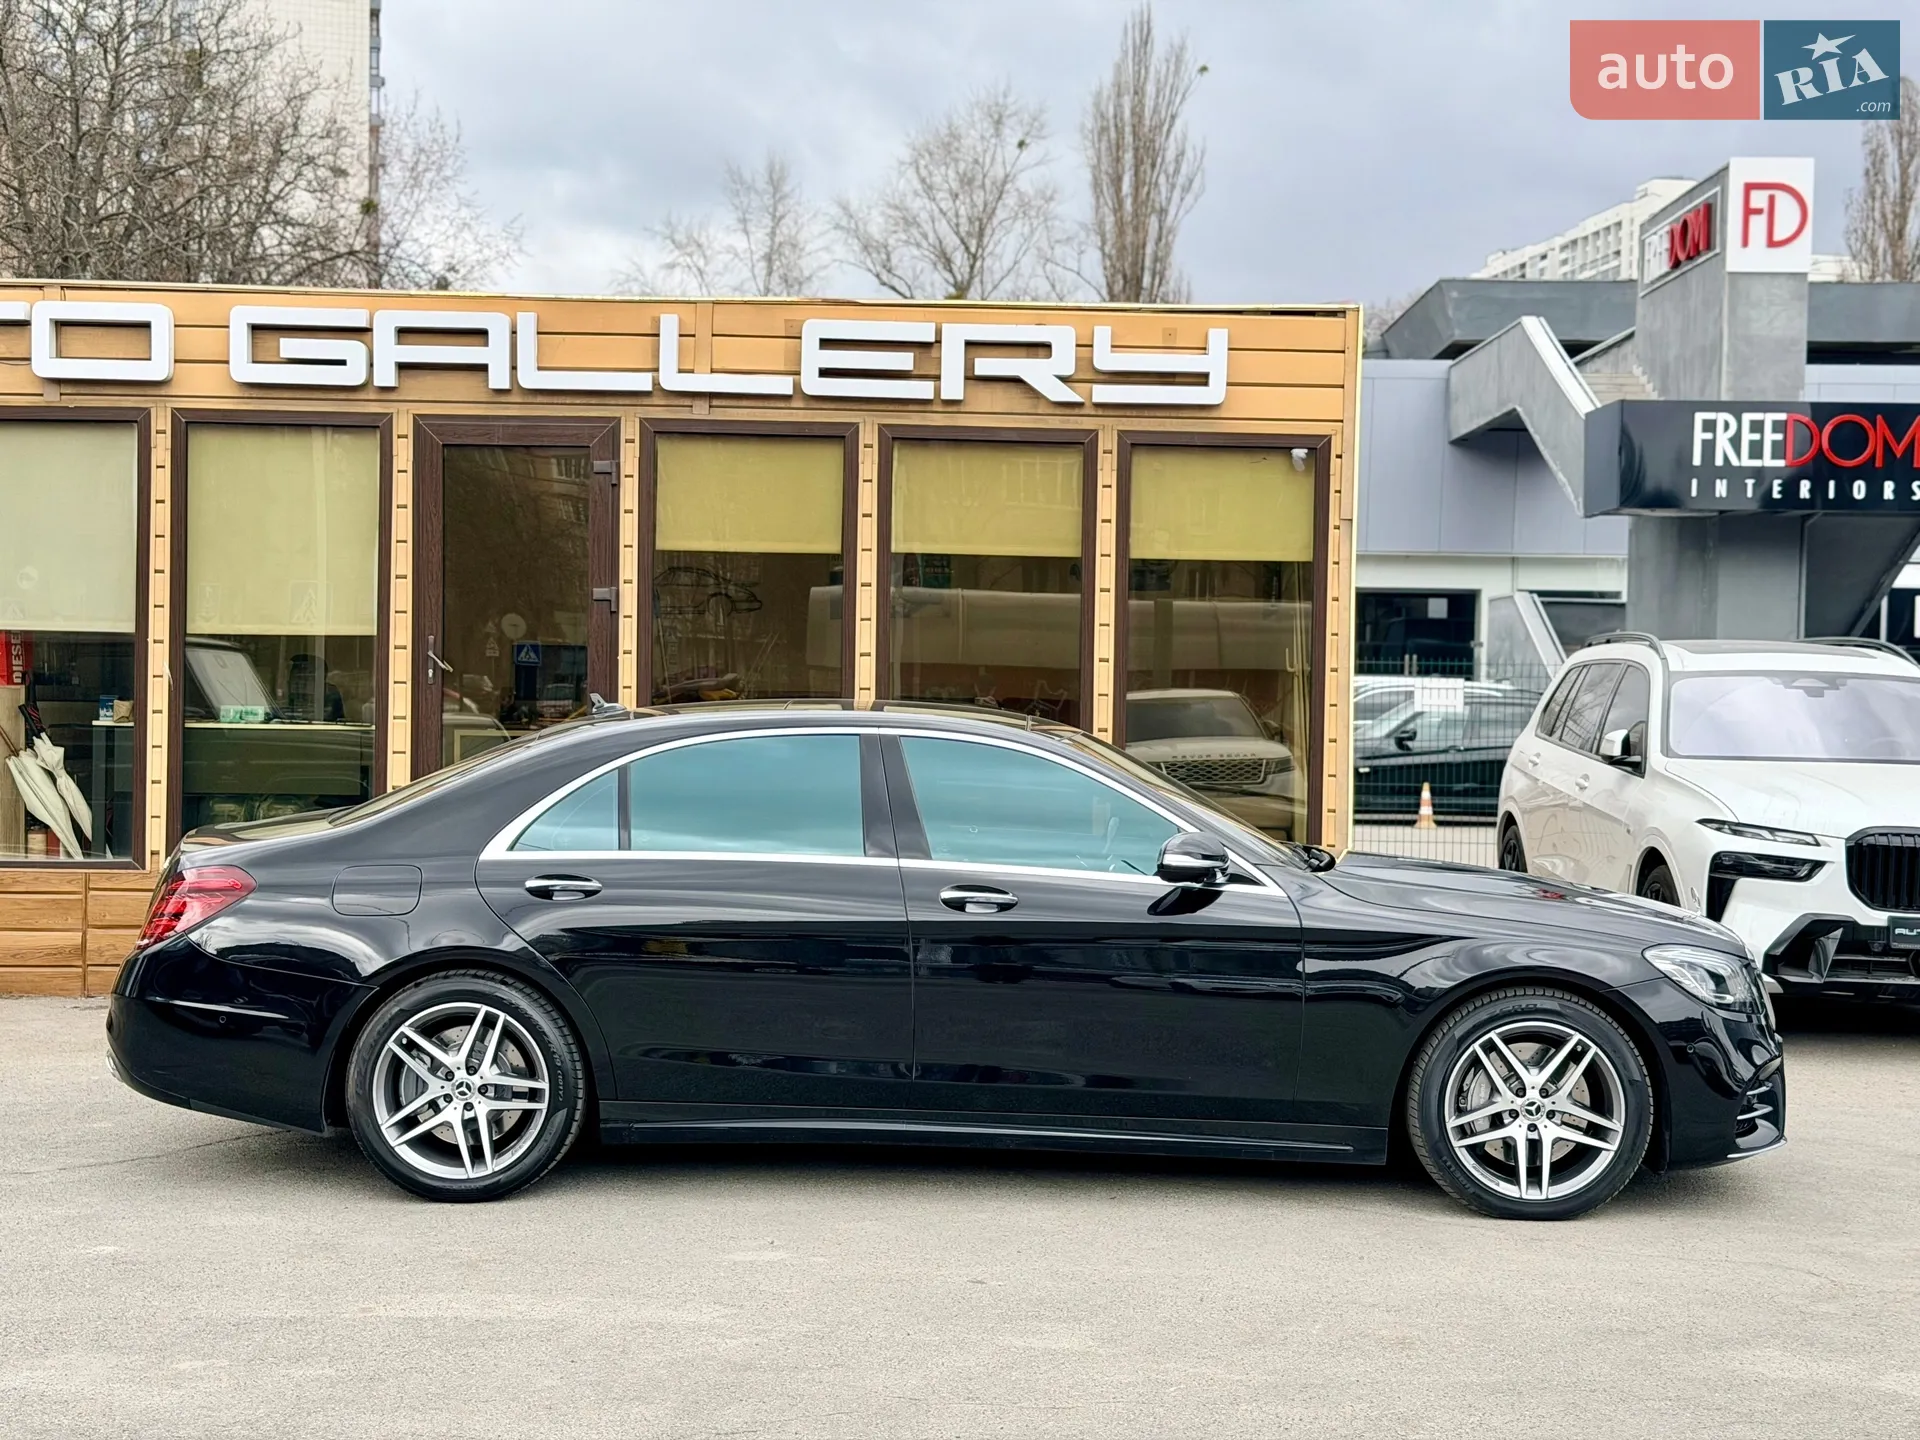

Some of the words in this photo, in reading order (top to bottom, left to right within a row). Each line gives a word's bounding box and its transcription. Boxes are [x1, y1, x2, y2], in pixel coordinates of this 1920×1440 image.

[1741, 181, 1809, 249] FD
[0, 300, 175, 382] O
[229, 304, 1229, 405] GALLERY
[1691, 411, 1920, 469] FREEDOM
[1690, 478, 1920, 500] INTERIORS
